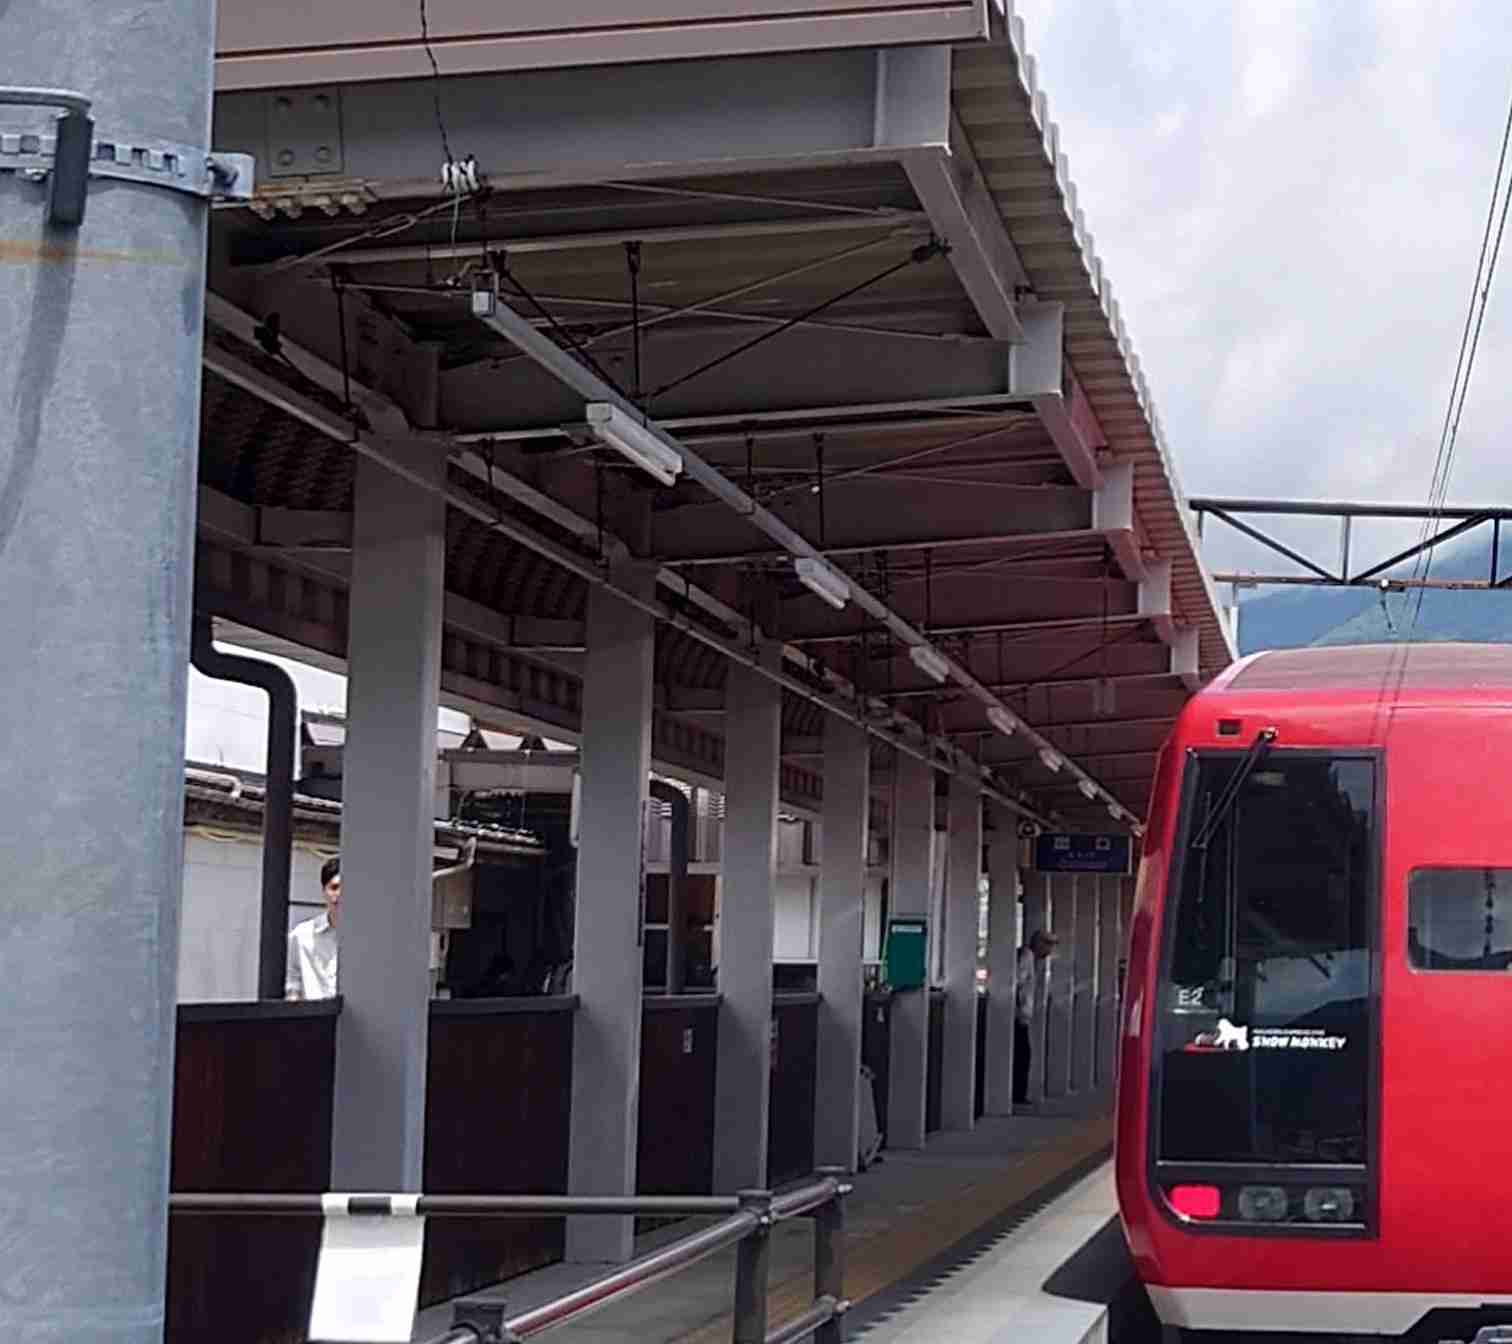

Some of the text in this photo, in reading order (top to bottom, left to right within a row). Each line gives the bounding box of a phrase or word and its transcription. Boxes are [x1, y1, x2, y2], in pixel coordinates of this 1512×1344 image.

[1178, 987, 1204, 1005] E2
[1252, 1036, 1346, 1049] SNOW MONKEY
